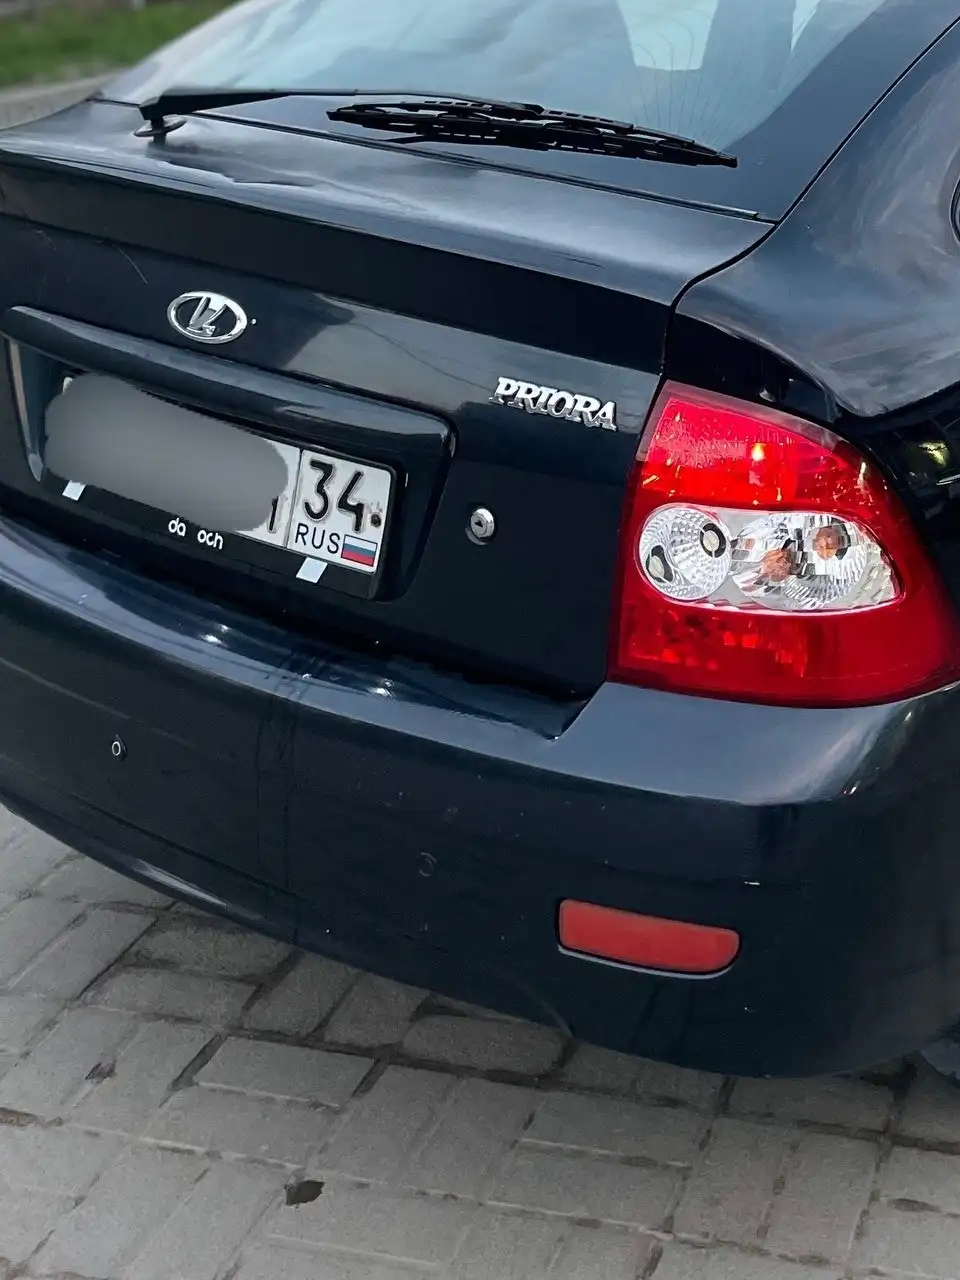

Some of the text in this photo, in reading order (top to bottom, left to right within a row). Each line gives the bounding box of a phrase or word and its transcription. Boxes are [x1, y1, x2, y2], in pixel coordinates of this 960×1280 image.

[489, 376, 617, 431] PRIORA
[304, 459, 365, 533] 34
[295, 523, 341, 554] RUS
